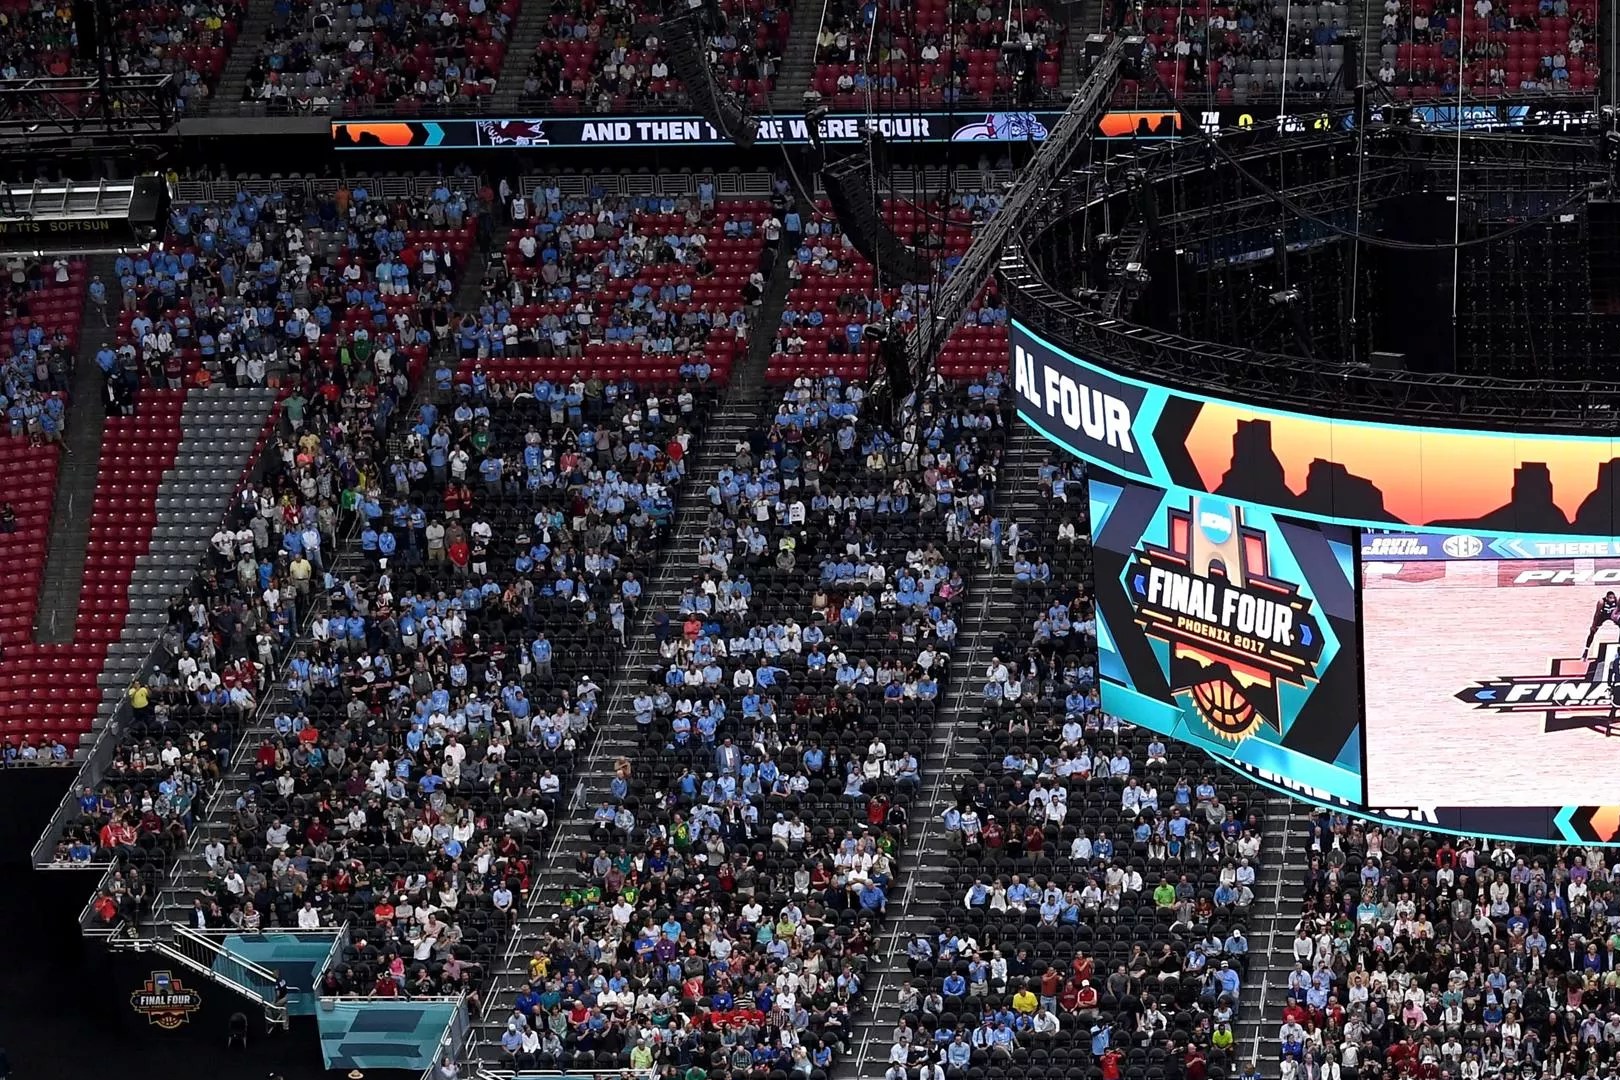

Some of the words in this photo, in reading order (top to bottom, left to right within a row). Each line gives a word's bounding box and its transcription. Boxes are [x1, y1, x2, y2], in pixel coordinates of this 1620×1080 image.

[581, 122, 630, 141] AND
[636, 121, 700, 140] THEN
[706, 120, 783, 139] TRE
[50, 221, 110, 232] SOFTSUN
[1043, 364, 1135, 454] FOUR
[1371, 538, 1419, 547] SOUTH
[1445, 538, 1481, 555] SEC
[1535, 541, 1609, 555] THERE
[1147, 566, 1218, 623] FINAL
[1221, 588, 1293, 647] FOUR
[1177, 616, 1231, 644] PHOENIX
[1234, 634, 1265, 654] 2017
[1505, 683, 1613, 702] FINA
[140, 995, 166, 1006] FINAL
[167, 994, 191, 1005] FOUR
